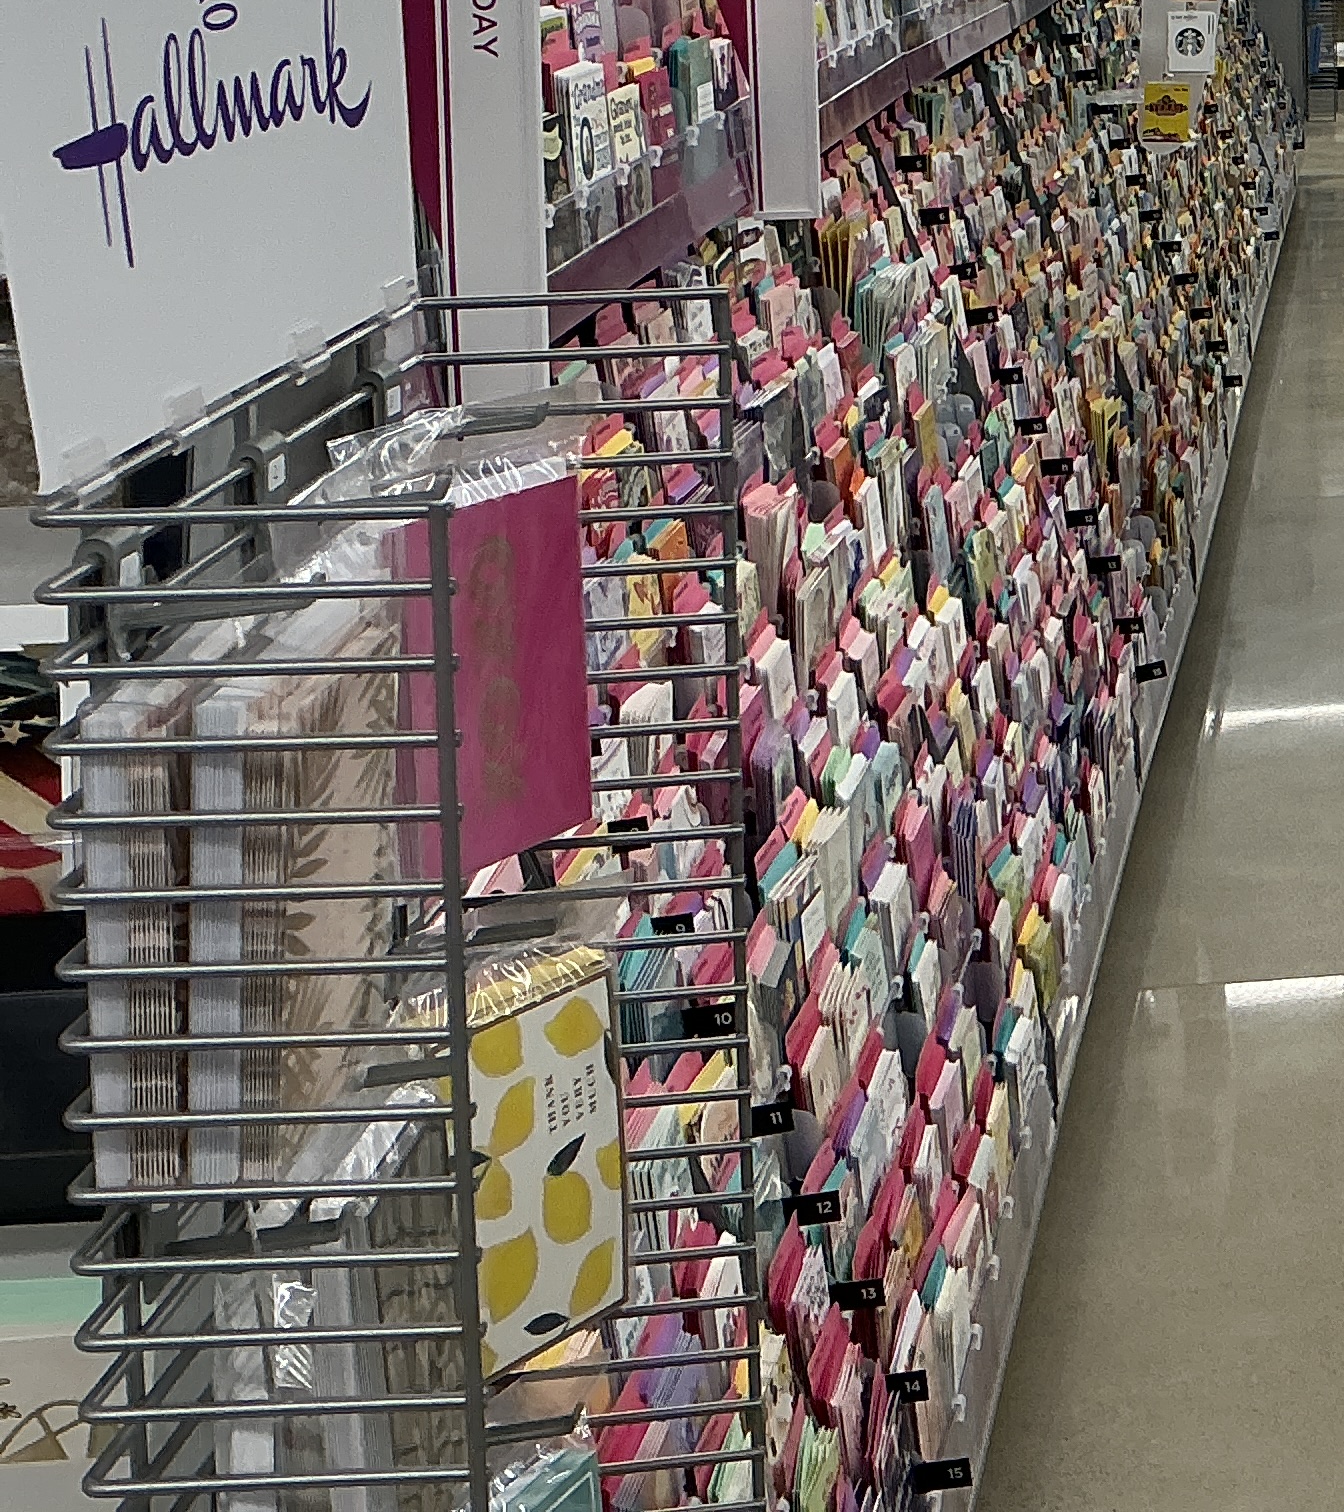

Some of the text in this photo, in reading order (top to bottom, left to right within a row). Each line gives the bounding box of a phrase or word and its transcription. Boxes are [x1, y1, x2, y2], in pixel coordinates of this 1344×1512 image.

[714, 1012, 733, 1026] 10
[544, 1074, 558, 1135] THANK
[560, 1092, 572, 1128] YOU
[572, 1076, 585, 1122] VERY
[585, 1063, 597, 1115] MUCH
